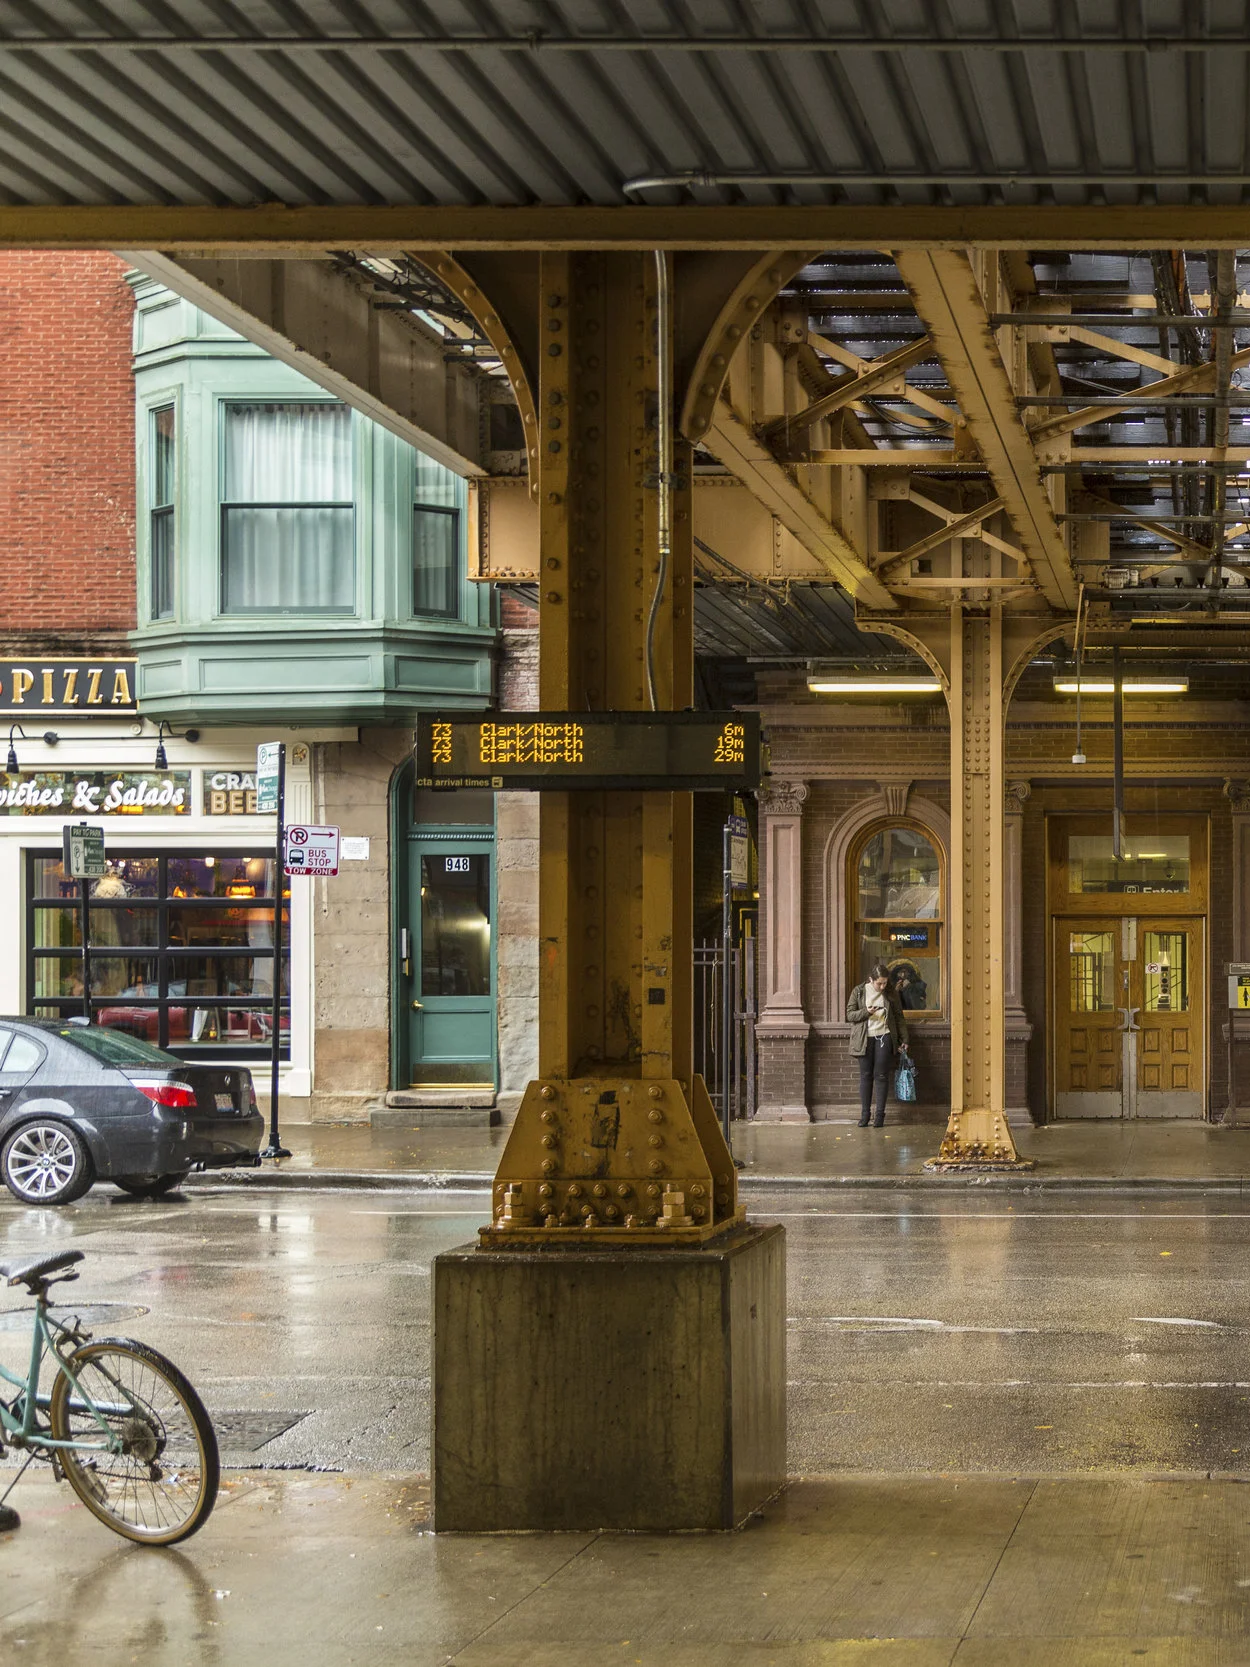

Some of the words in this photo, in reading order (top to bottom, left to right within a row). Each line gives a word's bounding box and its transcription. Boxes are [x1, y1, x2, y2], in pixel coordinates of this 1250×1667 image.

[11, 668, 132, 704] PIZZA
[431, 723, 452, 736] 73
[479, 723, 583, 736] Clark/North
[724, 723, 744, 736] 6m
[431, 736, 452, 750] 73
[479, 736, 583, 750] Clark/North
[717, 736, 744, 750] 19m
[431, 749, 452, 763] 73
[479, 749, 583, 763] Clark/North
[714, 749, 744, 763] 29m
[211, 774, 258, 791] CRA
[417, 778, 433, 786] cta
[434, 777, 463, 786] arrival
[465, 777, 489, 786] times
[72, 781, 100, 812] &
[104, 779, 185, 811] Salads
[211, 791, 258, 814] BEE
[308, 849, 327, 857] BUS
[308, 858, 332, 867] STOP
[446, 858, 469, 871] 948
[288, 867, 307, 875] TOW
[310, 867, 334, 876] ZONE
